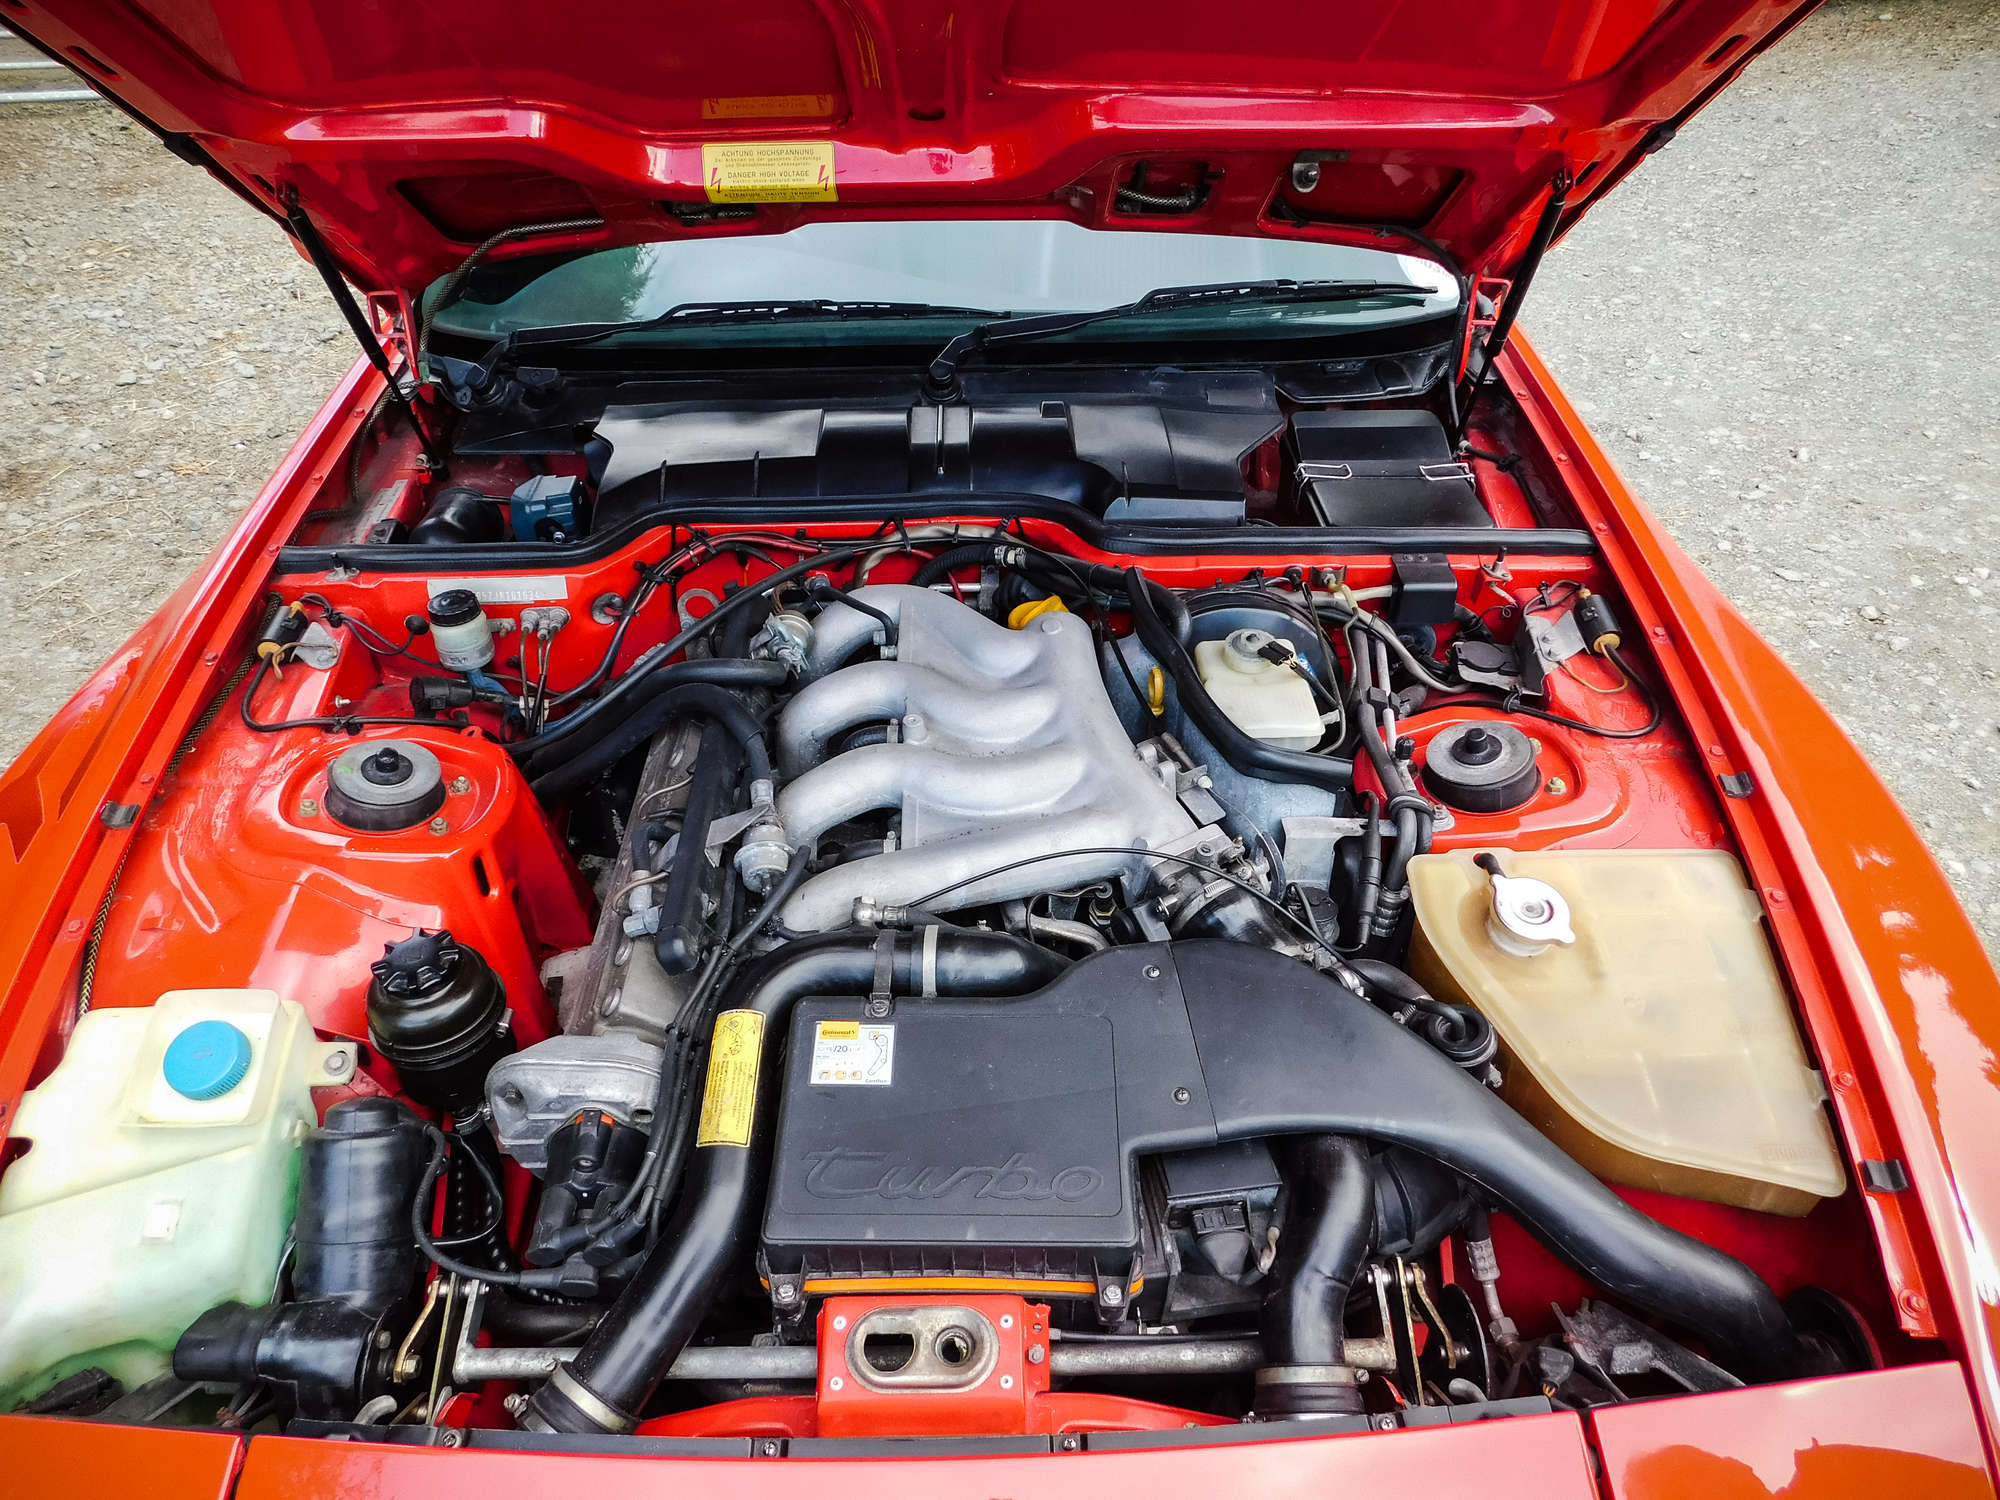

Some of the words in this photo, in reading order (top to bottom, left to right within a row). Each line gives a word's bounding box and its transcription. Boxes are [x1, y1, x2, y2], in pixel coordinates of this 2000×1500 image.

[721, 150, 754, 158] ACHTUNG
[757, 148, 815, 157] HOCHSPANNUNG
[727, 171, 756, 179] DANGER
[779, 170, 809, 178] VOLTAGE
[801, 1146, 1105, 1202] turbo
